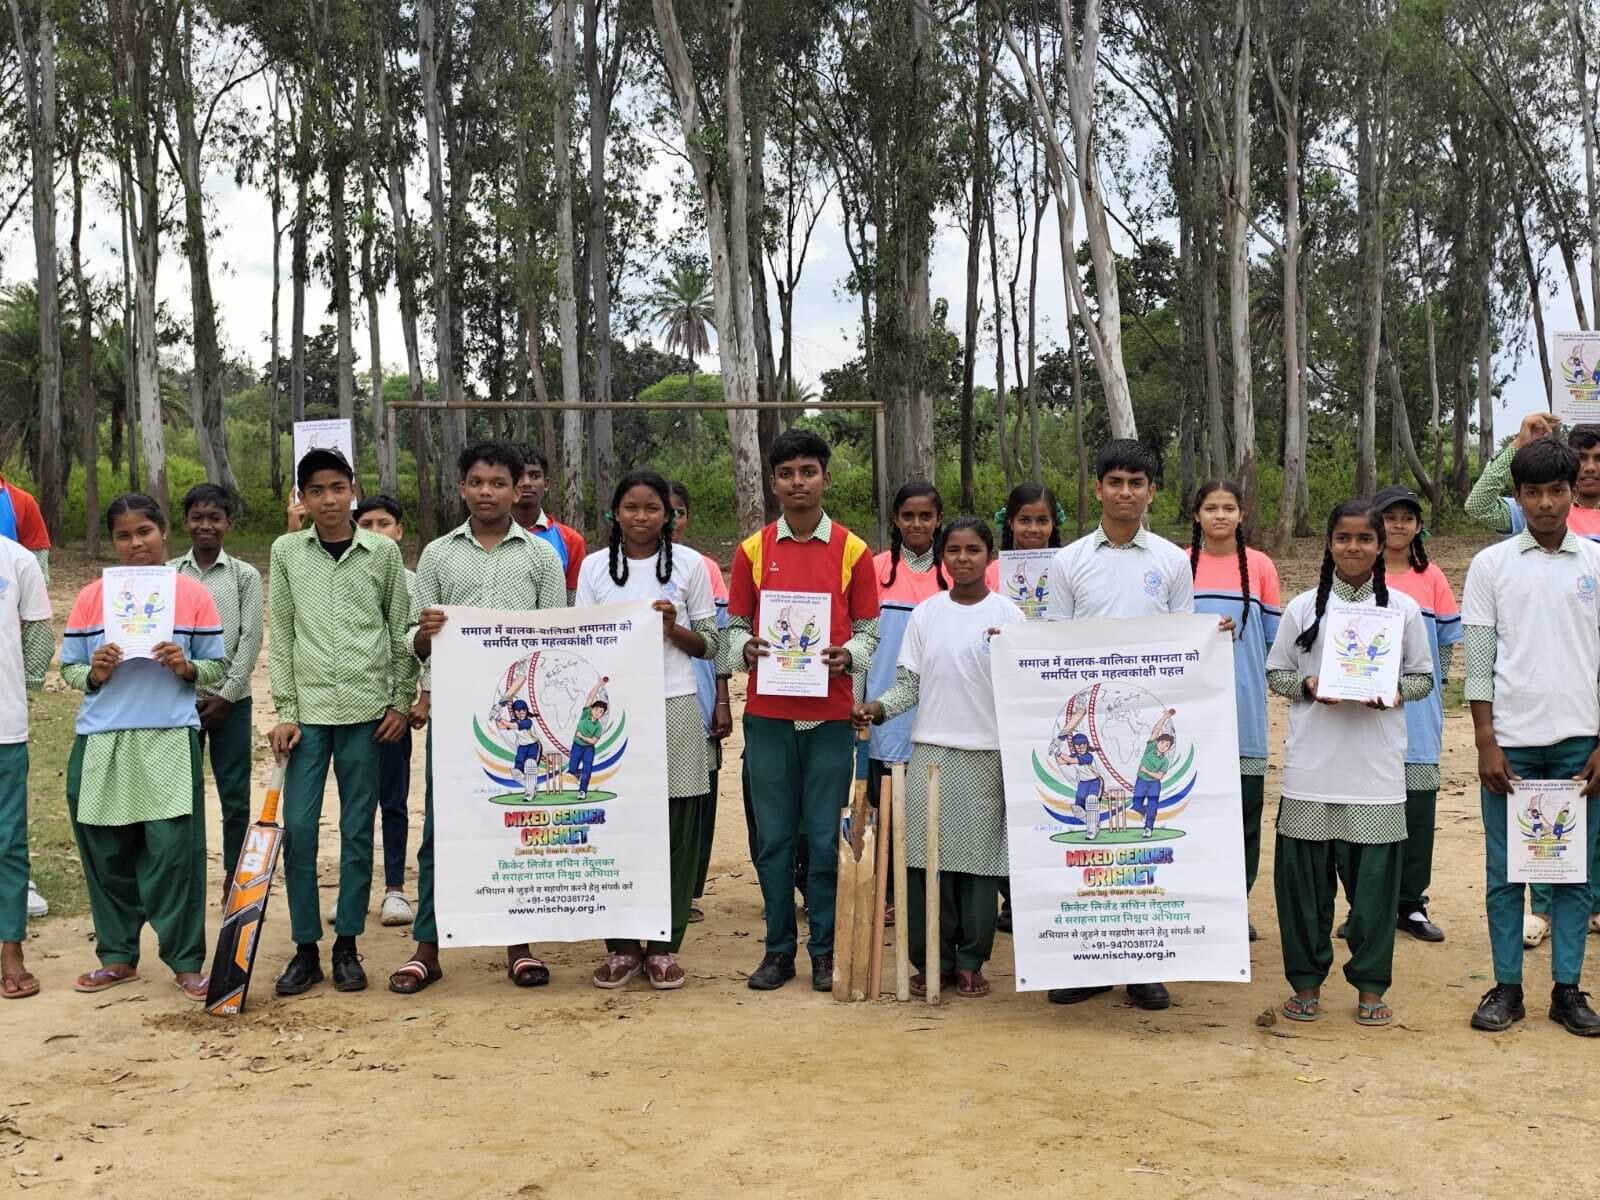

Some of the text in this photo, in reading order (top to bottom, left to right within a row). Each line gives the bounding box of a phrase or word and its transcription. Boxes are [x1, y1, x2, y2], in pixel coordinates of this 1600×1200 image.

[461, 620, 632, 636] समाज में बालक-बालिका समानता को
[482, 637, 518, 648] समर्पित
[521, 637, 538, 649] एक
[596, 636, 617, 645] पहल
[1018, 650, 1200, 668] समाज में बालक-बालिका समानता को
[1041, 668, 1077, 680] समर्पित
[1081, 669, 1098, 680] एक
[1160, 666, 1184, 676] पहल
[505, 808, 605, 827] MIXED GENDER
[521, 827, 591, 847] CRICKET
[556, 858, 579, 868] सचिन
[1066, 847, 1174, 867] MIXED GENDER
[584, 869, 620, 878] अभियान
[1083, 866, 1157, 887] CRICKET
[509, 904, 606, 915] www.nischay.org.in
[1121, 899, 1145, 909] सचिन
[1065, 915, 1097, 925] सराहना
[1100, 914, 1120, 923] प्राप्त
[1152, 911, 1190, 921] अभियान
[1038, 930, 1069, 939] अभियान
[1108, 928, 1135, 937] सहयोग
[1137, 927, 1154, 936] करने
[1157, 927, 1168, 937] हेतु
[1091, 940, 1163, 949] +91-9470381724
[1073, 950, 1176, 961] www.nischay.org.in
